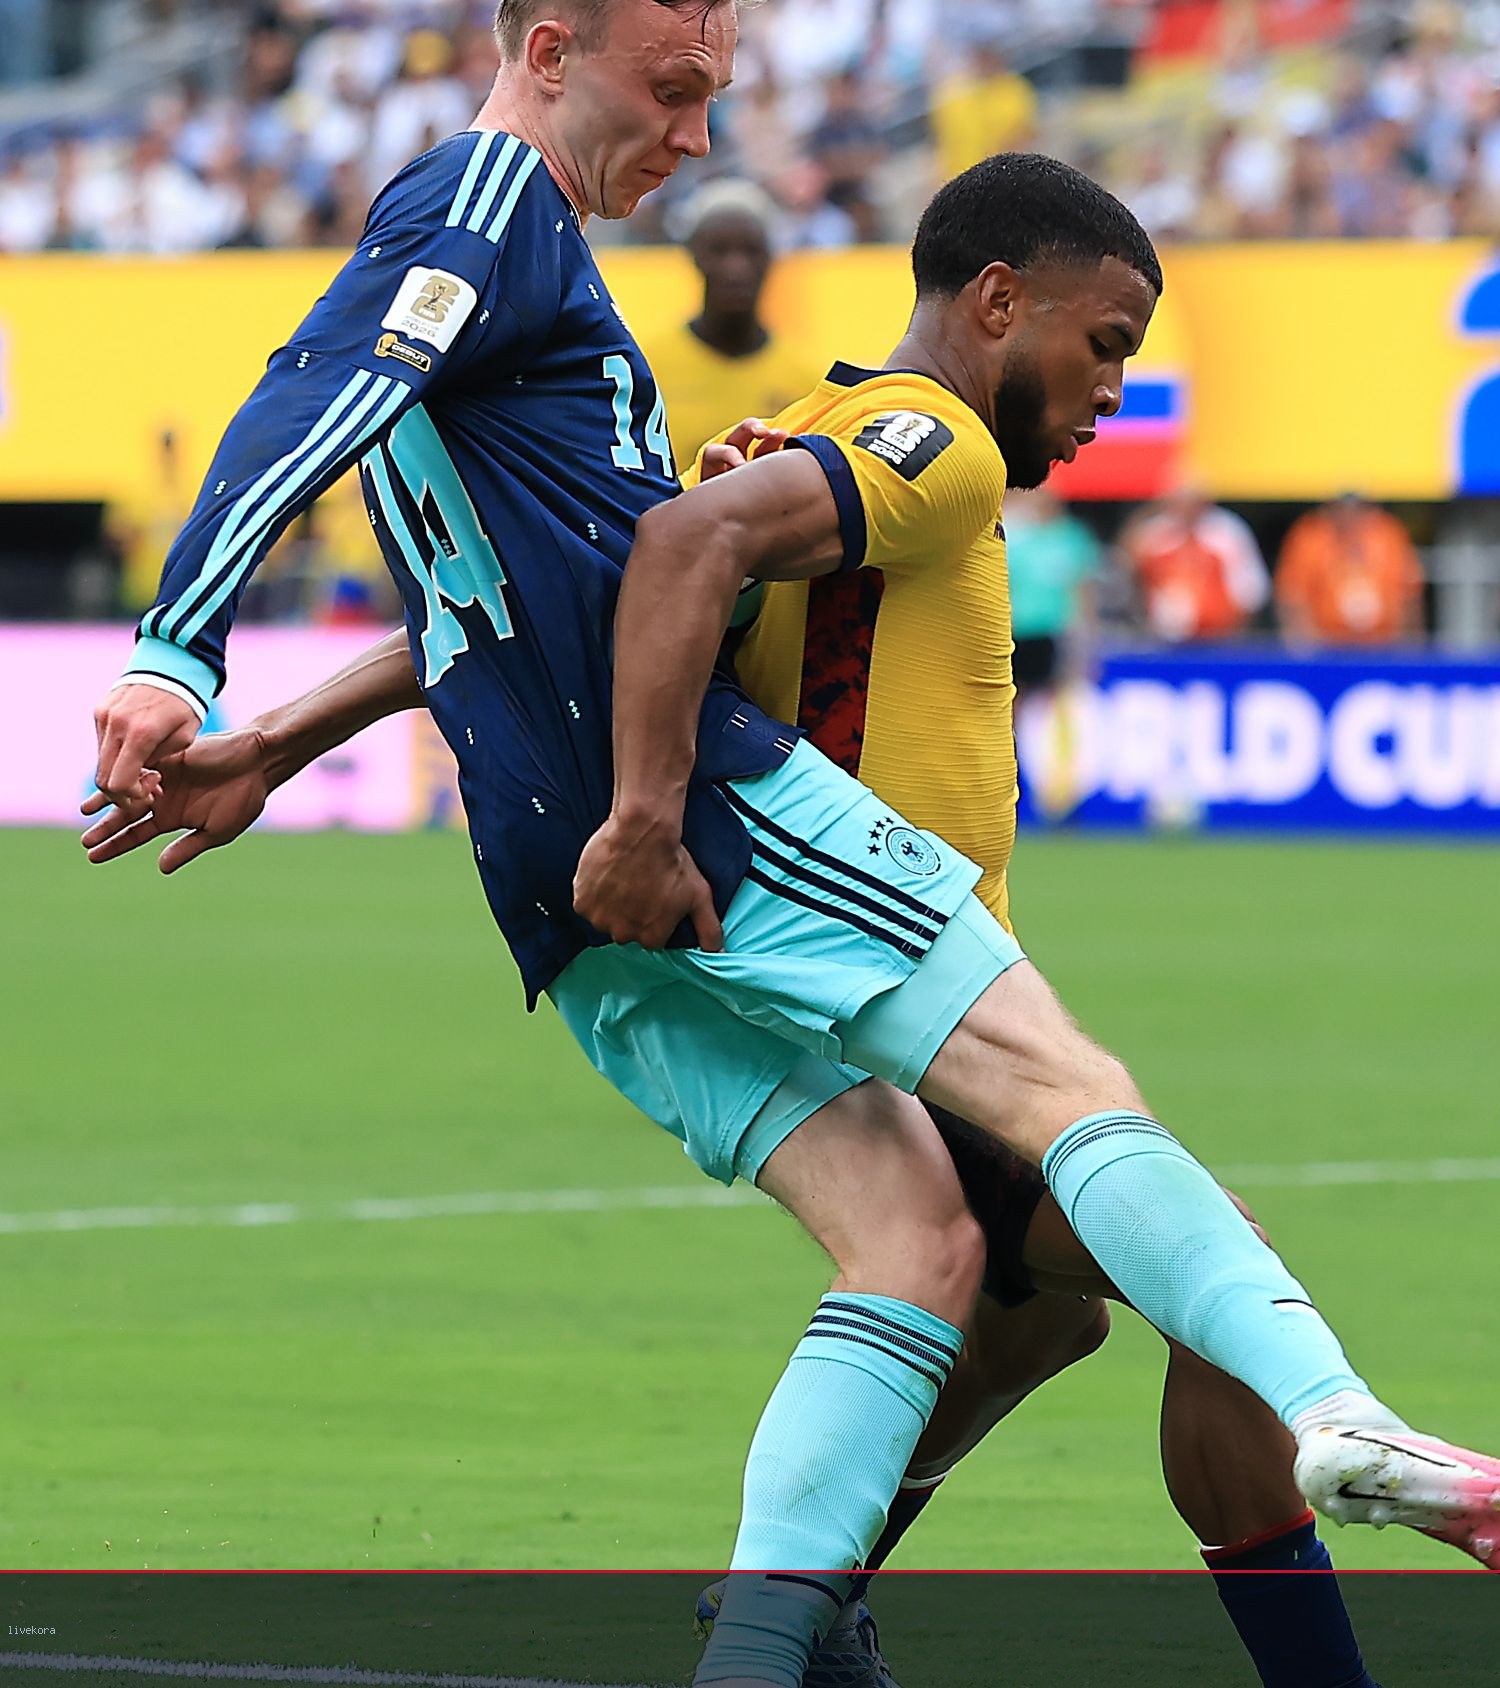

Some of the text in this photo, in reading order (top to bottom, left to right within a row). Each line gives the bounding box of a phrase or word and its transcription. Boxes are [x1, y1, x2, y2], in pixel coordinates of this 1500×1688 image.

[401, 319, 436, 338] 2026
[391, 343, 428, 363] DEBUT
[602, 354, 673, 479] 14
[890, 433, 906, 446] FIFA
